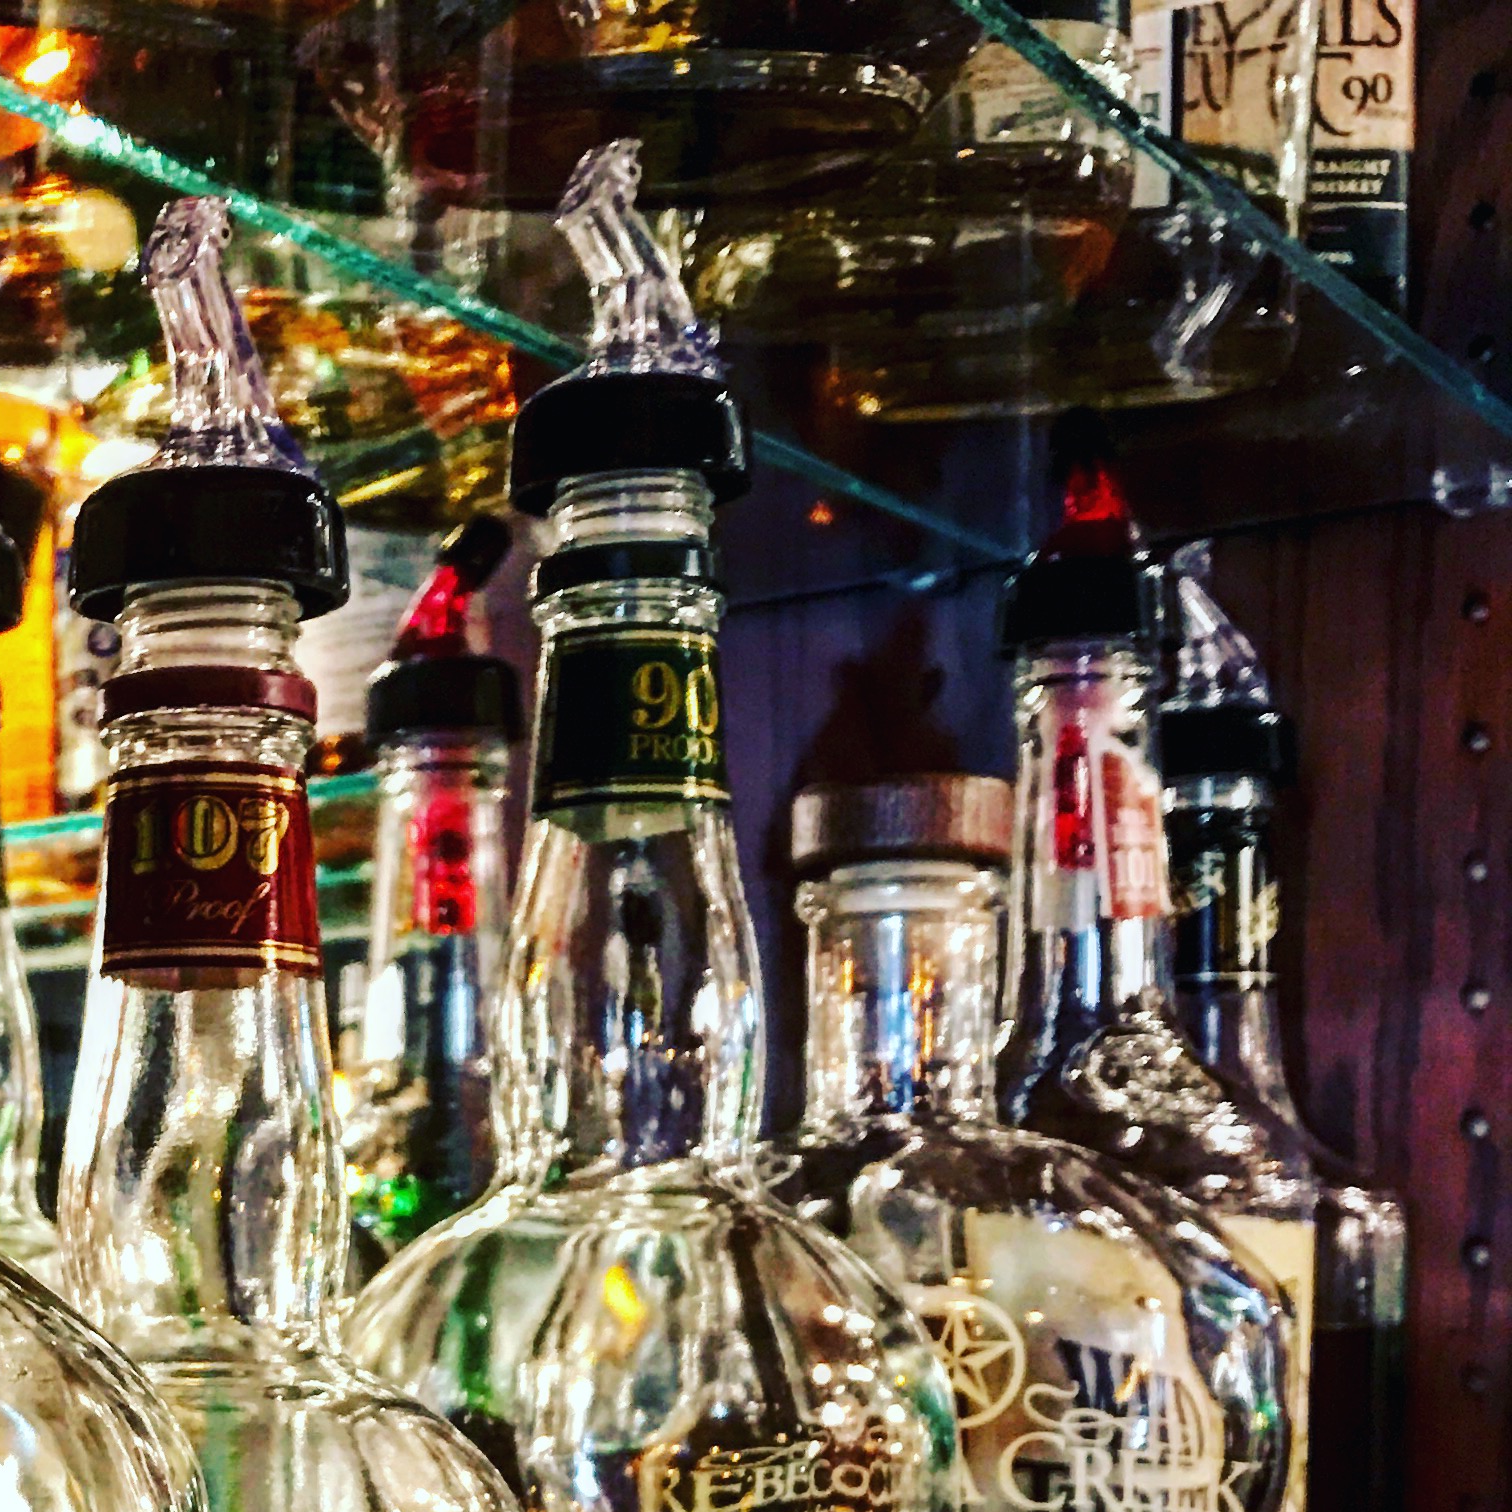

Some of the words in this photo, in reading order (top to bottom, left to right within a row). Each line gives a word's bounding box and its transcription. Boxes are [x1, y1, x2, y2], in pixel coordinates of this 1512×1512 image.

[632, 661, 719, 736] 90
[131, 795, 290, 875] 107
[164, 879, 271, 935] Proof
